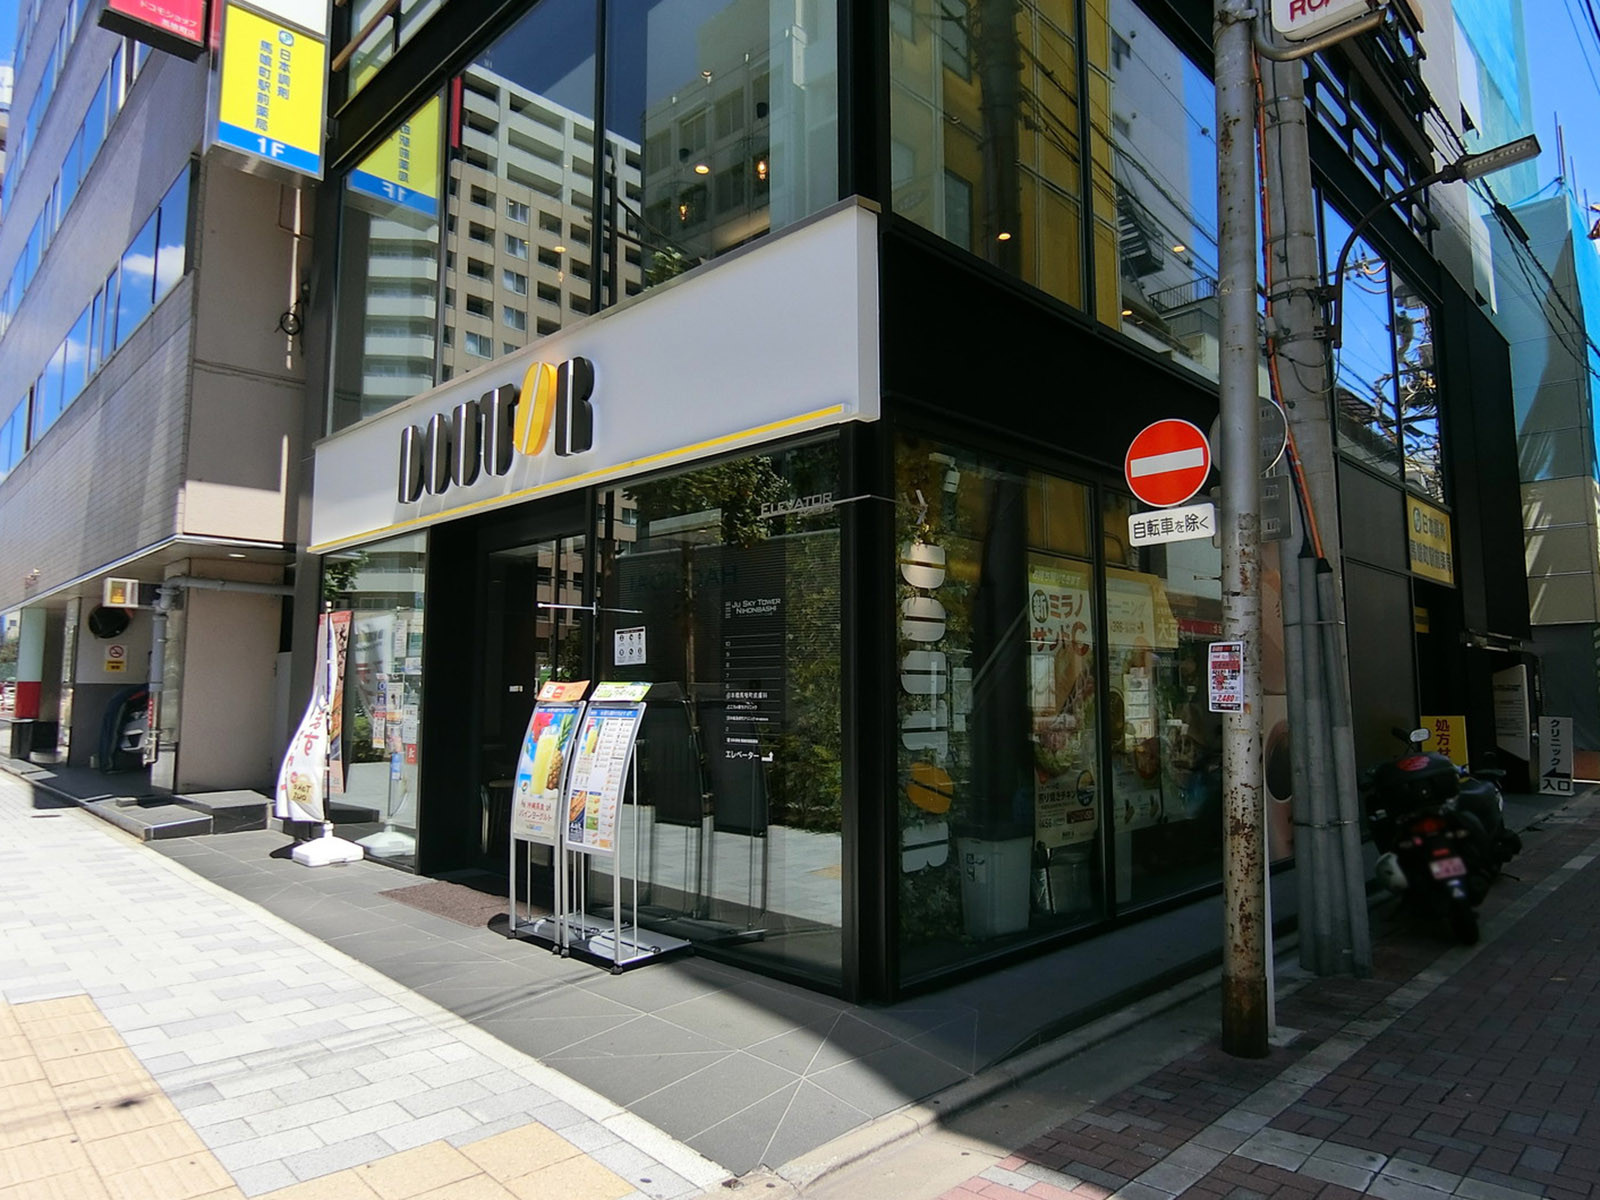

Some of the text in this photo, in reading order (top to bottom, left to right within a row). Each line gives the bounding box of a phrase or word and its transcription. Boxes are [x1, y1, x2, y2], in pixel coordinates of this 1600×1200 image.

[277, 48, 291, 100] 日本調剤
[257, 137, 286, 158] 1F
[398, 356, 595, 504] DOUTOR
[760, 492, 833, 516] ELEVATOR
[1133, 513, 1209, 539] 自転車を除く
[1049, 594, 1083, 618] ミラノ
[1550, 718, 1562, 767] クリニック
[725, 750, 760, 760] エレベーター
[1542, 779, 1570, 792] 入口
